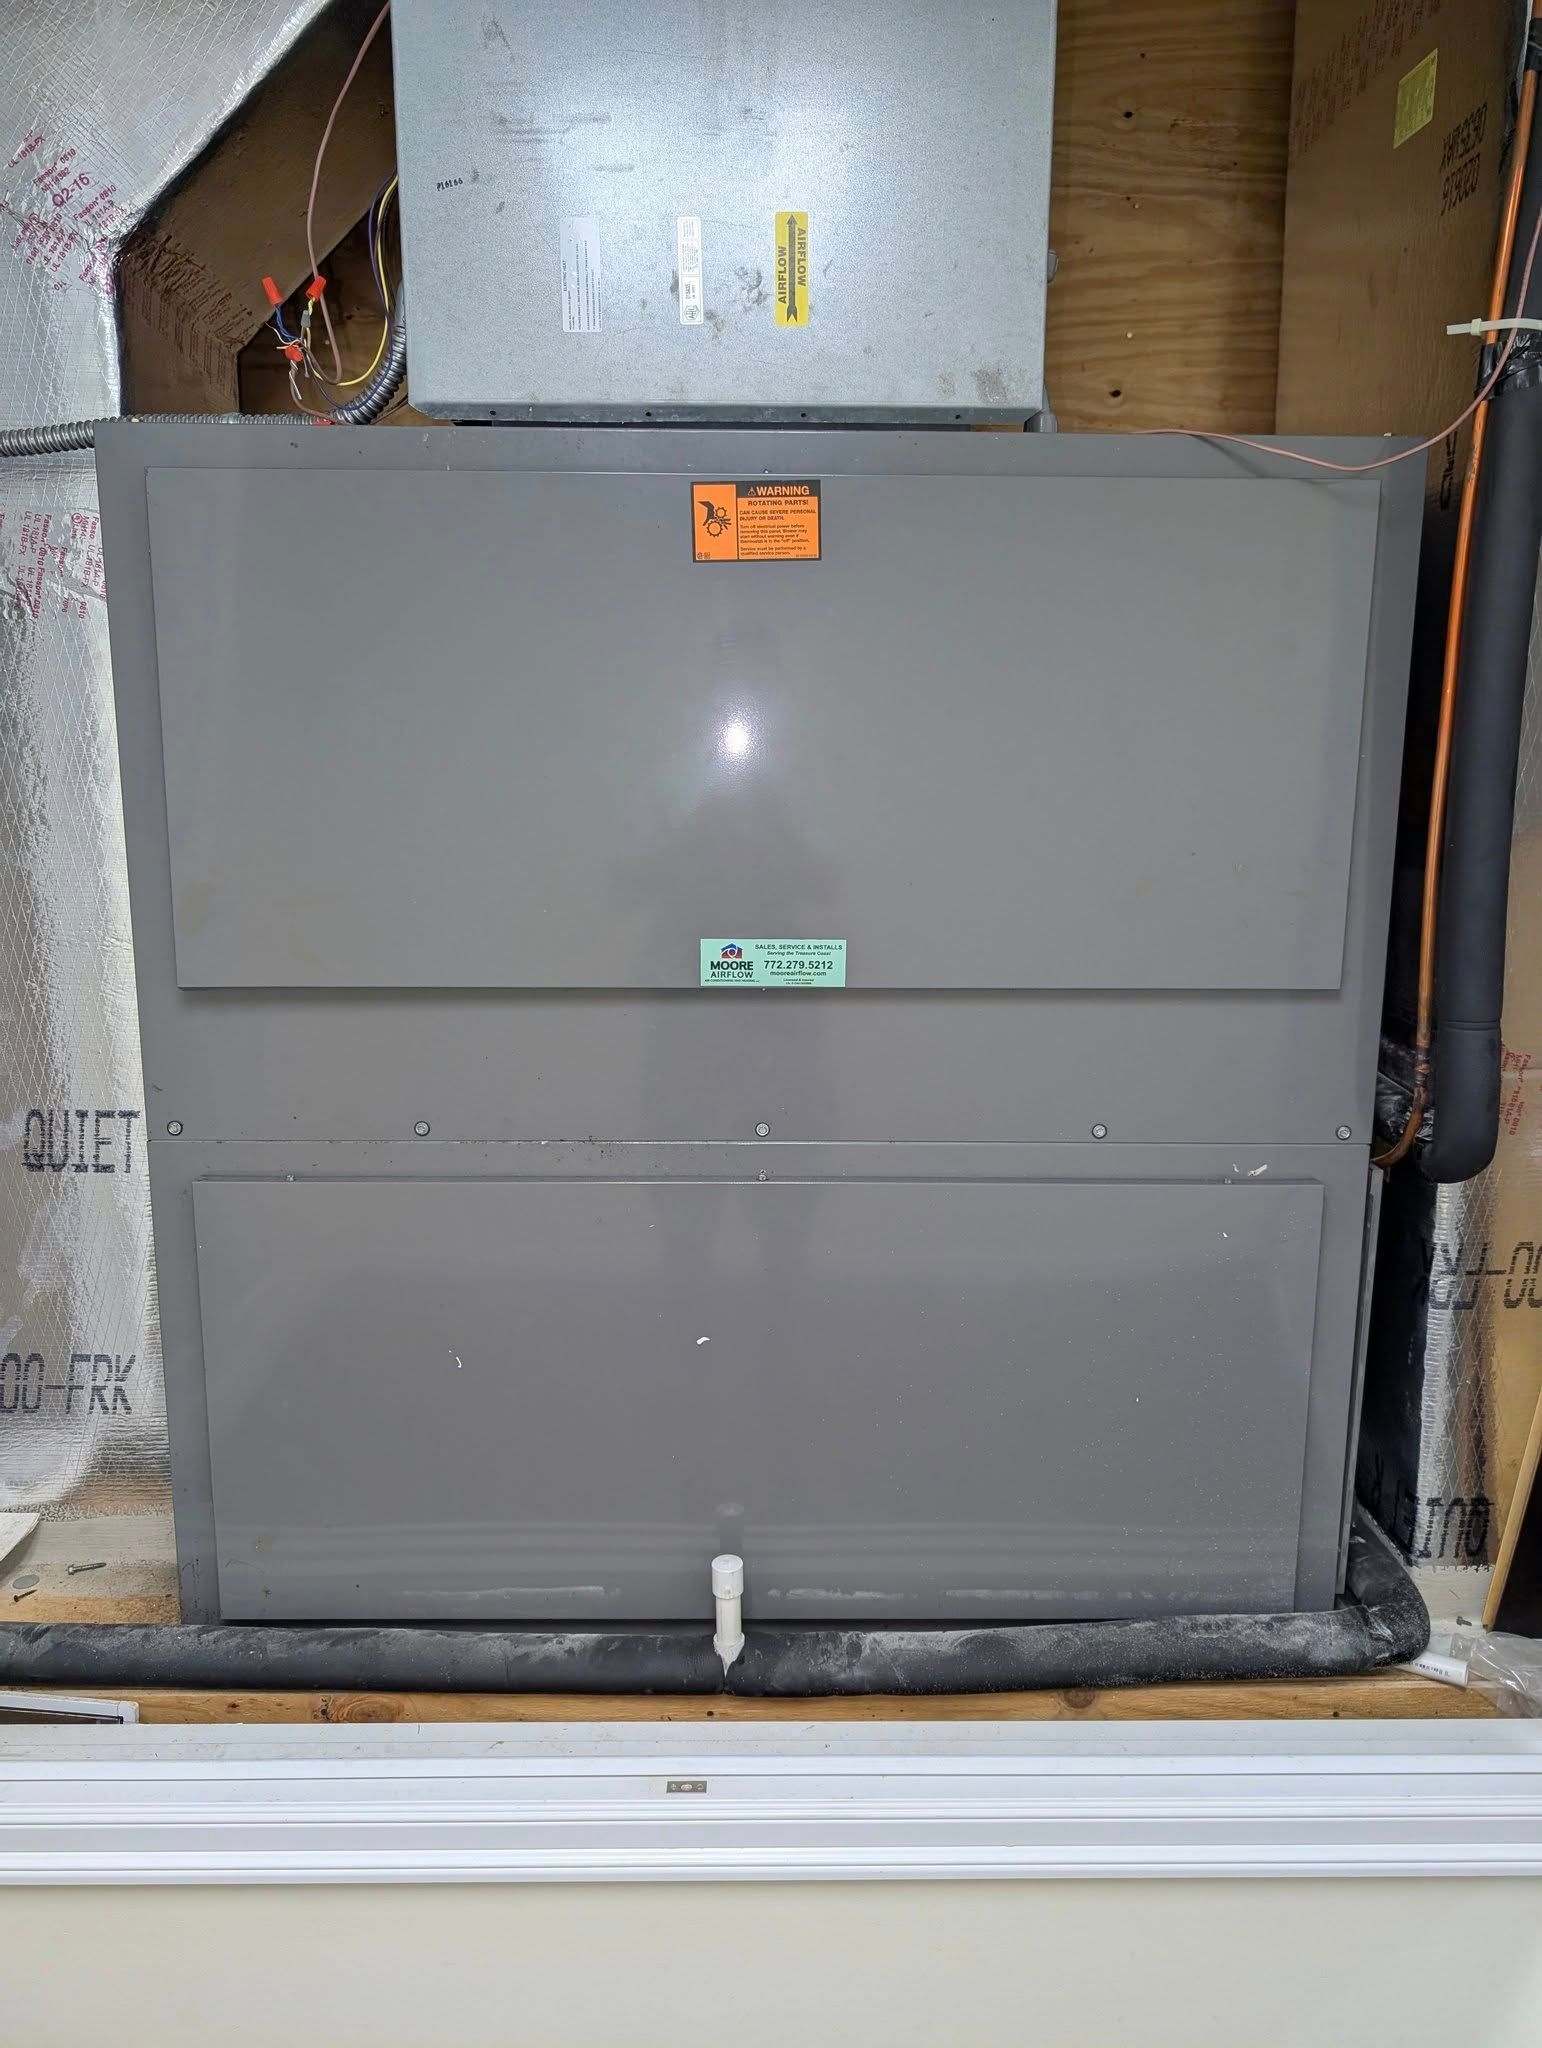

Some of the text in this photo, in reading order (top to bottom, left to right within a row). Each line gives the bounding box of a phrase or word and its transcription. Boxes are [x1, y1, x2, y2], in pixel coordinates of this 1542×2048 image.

[60, 148, 77, 164] 0810
[52, 173, 90, 207] Q2-16
[99, 184, 117, 200] 0810
[796, 228, 807, 286] AIRFLOW
[778, 246, 787, 304] AIRFLOW
[756, 485, 810, 496] WARNING
[710, 961, 754, 970] MOORE
[764, 960, 833, 969] 772.279.5212
[22, 1108, 140, 1174] QUIET
